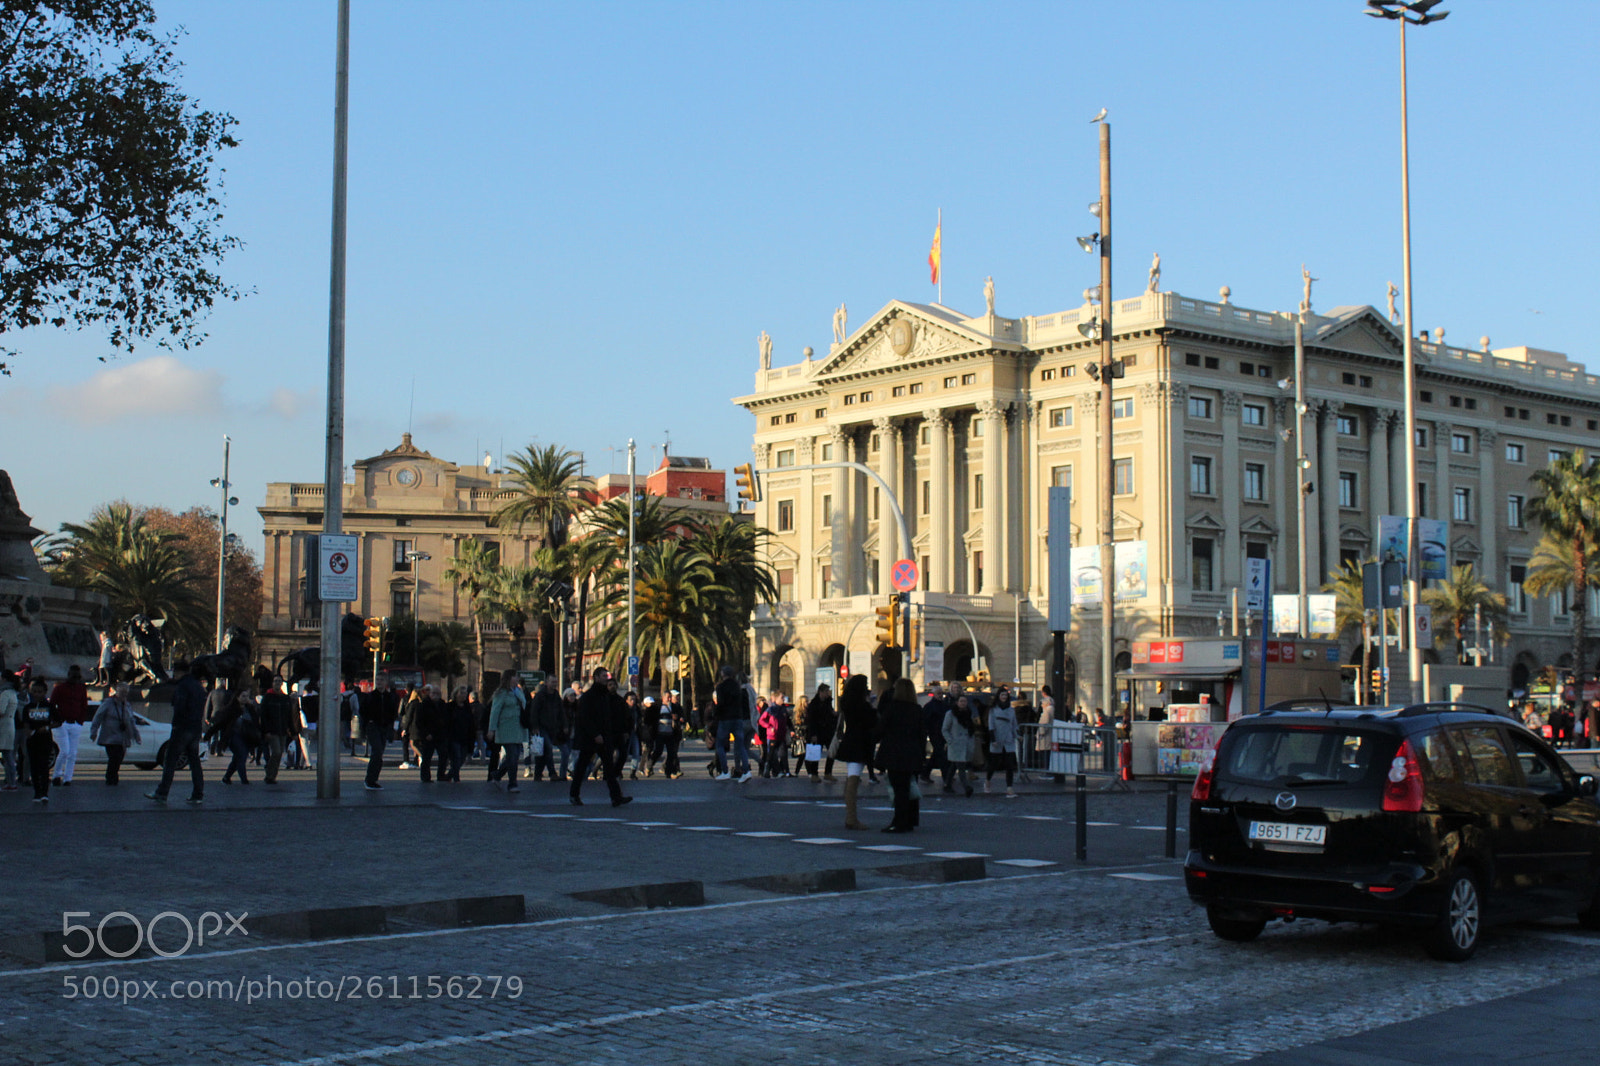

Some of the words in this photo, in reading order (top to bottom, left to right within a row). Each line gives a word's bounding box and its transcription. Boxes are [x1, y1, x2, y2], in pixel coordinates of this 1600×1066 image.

[629, 657, 637, 668] P
[1258, 824, 1290, 839] 9651
[1296, 827, 1323, 842] FZJ
